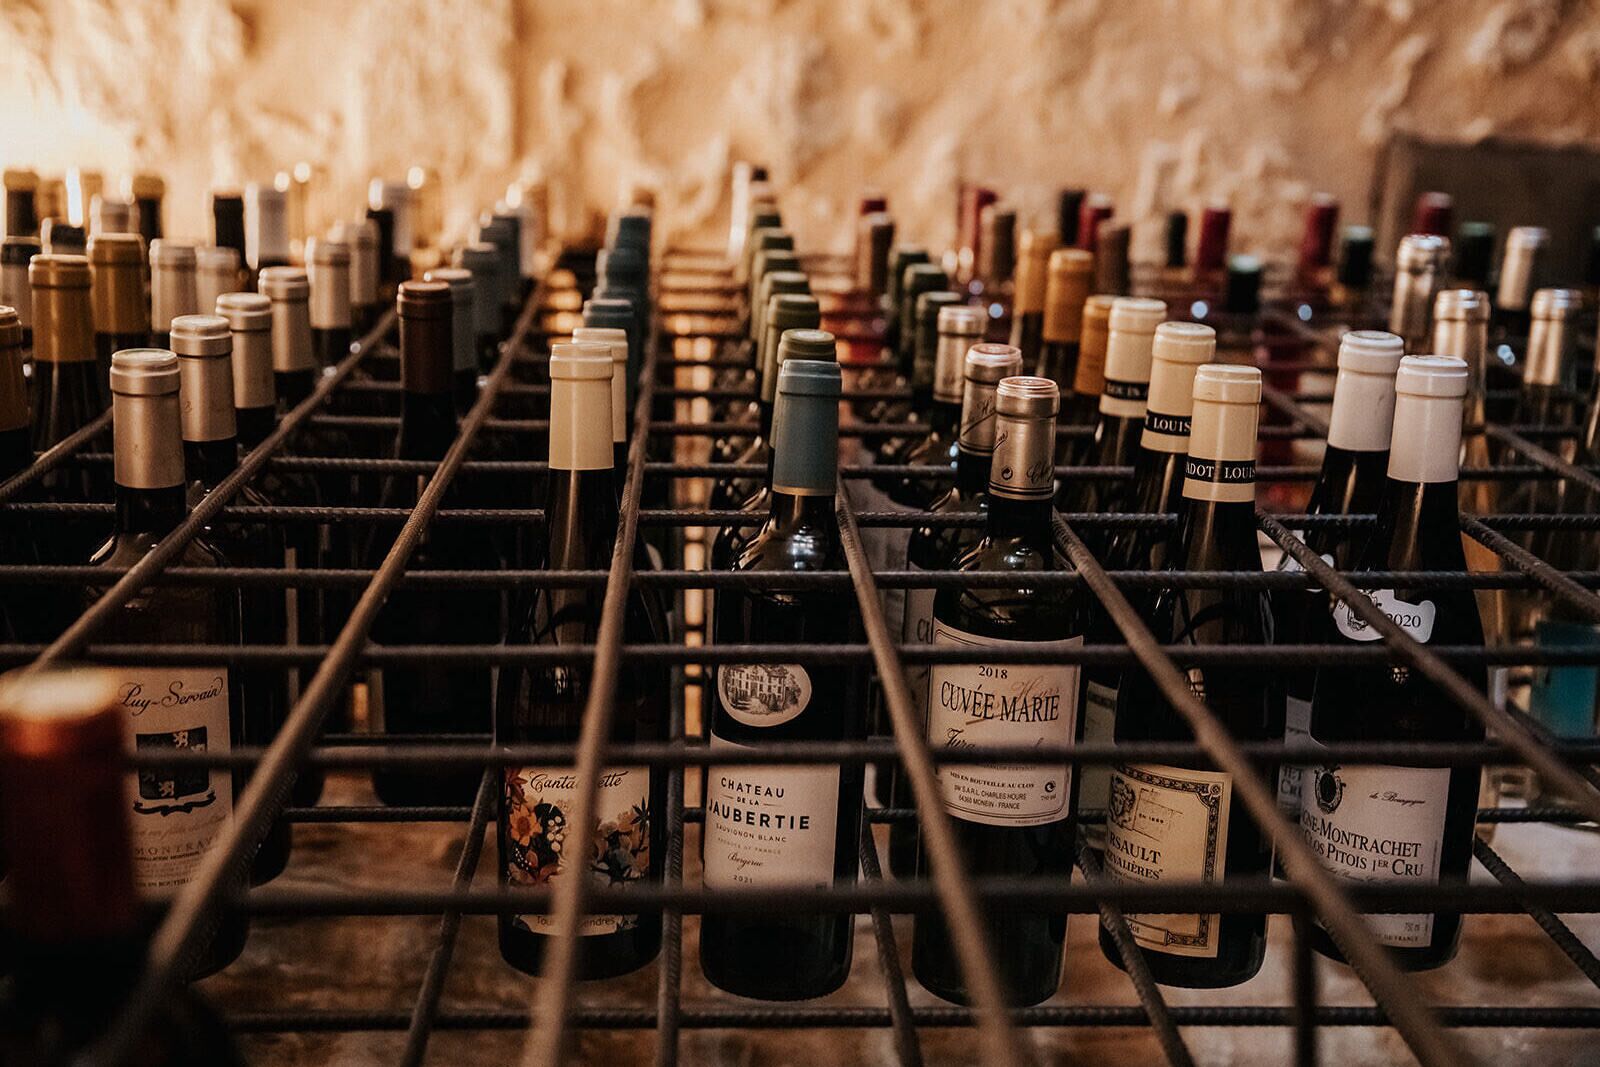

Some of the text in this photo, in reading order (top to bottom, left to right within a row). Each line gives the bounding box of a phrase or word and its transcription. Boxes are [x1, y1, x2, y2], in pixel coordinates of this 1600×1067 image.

[1153, 416, 1191, 433] LOUIS
[978, 665, 1008, 680] 2018
[941, 681, 1060, 723] CUVÉE MARIE
[720, 777, 785, 798] CHATEAU
[736, 796, 746, 804] DE
[708, 799, 810, 830] JAUBERTIE
[716, 823, 787, 843] SAUVIGNON BLANC
[135, 837, 213, 856] MONTRAV
[1326, 843, 1368, 870] PITOIS
[1391, 858, 1424, 876] CRU
